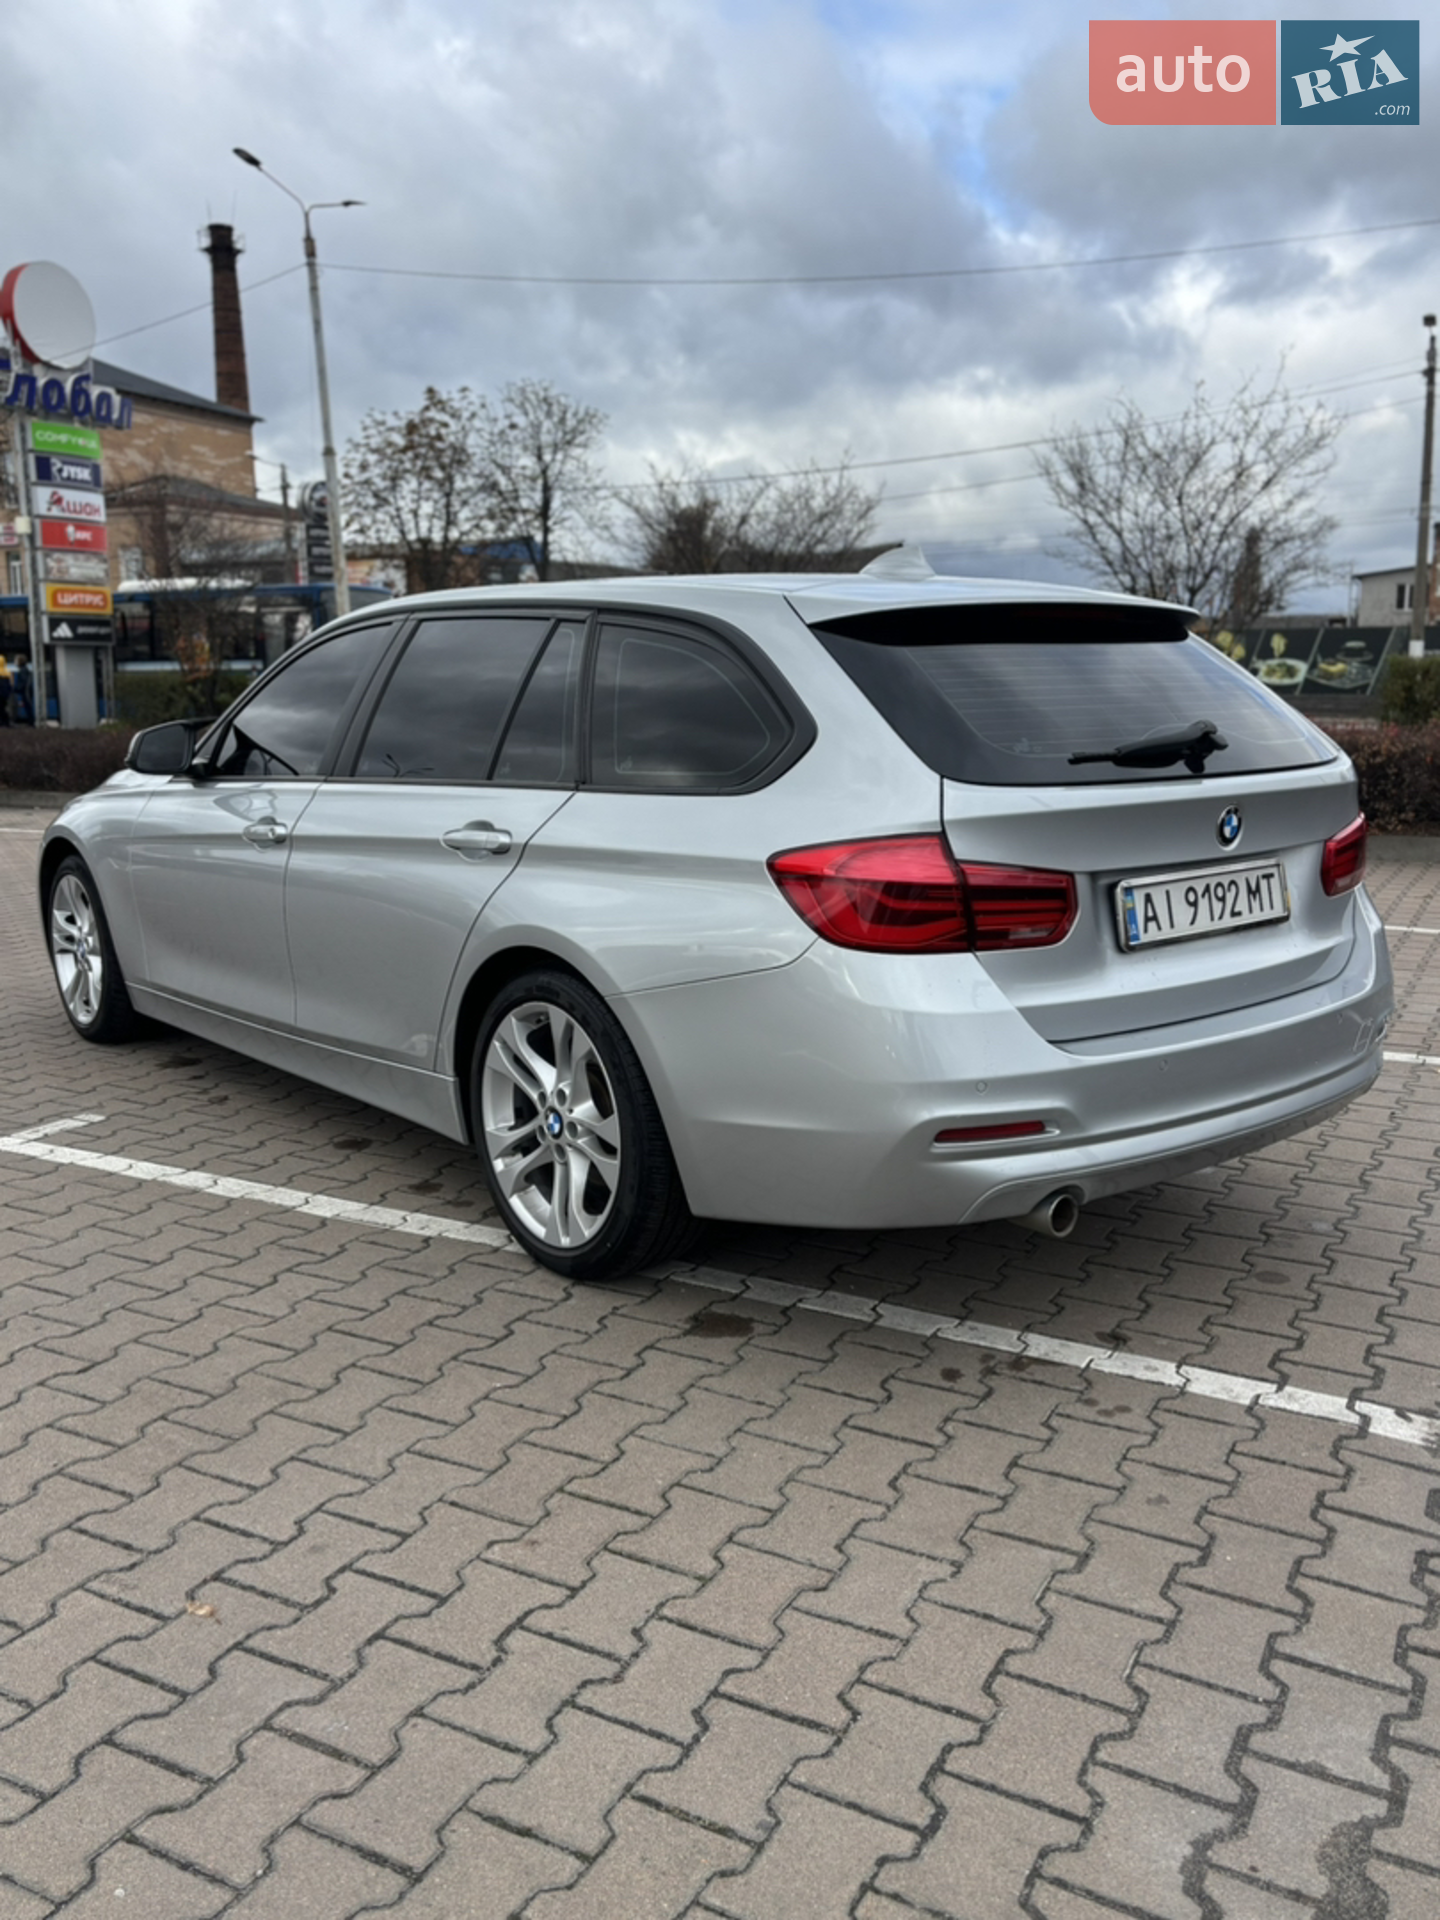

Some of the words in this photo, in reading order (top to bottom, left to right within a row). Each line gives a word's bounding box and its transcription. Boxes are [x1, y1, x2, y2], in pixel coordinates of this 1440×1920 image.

[0, 358, 132, 429] лобал
[61, 465, 91, 480] JYSK
[1143, 890, 1174, 934] AI
[1184, 880, 1242, 926] 9192
[1245, 873, 1275, 914] MT
